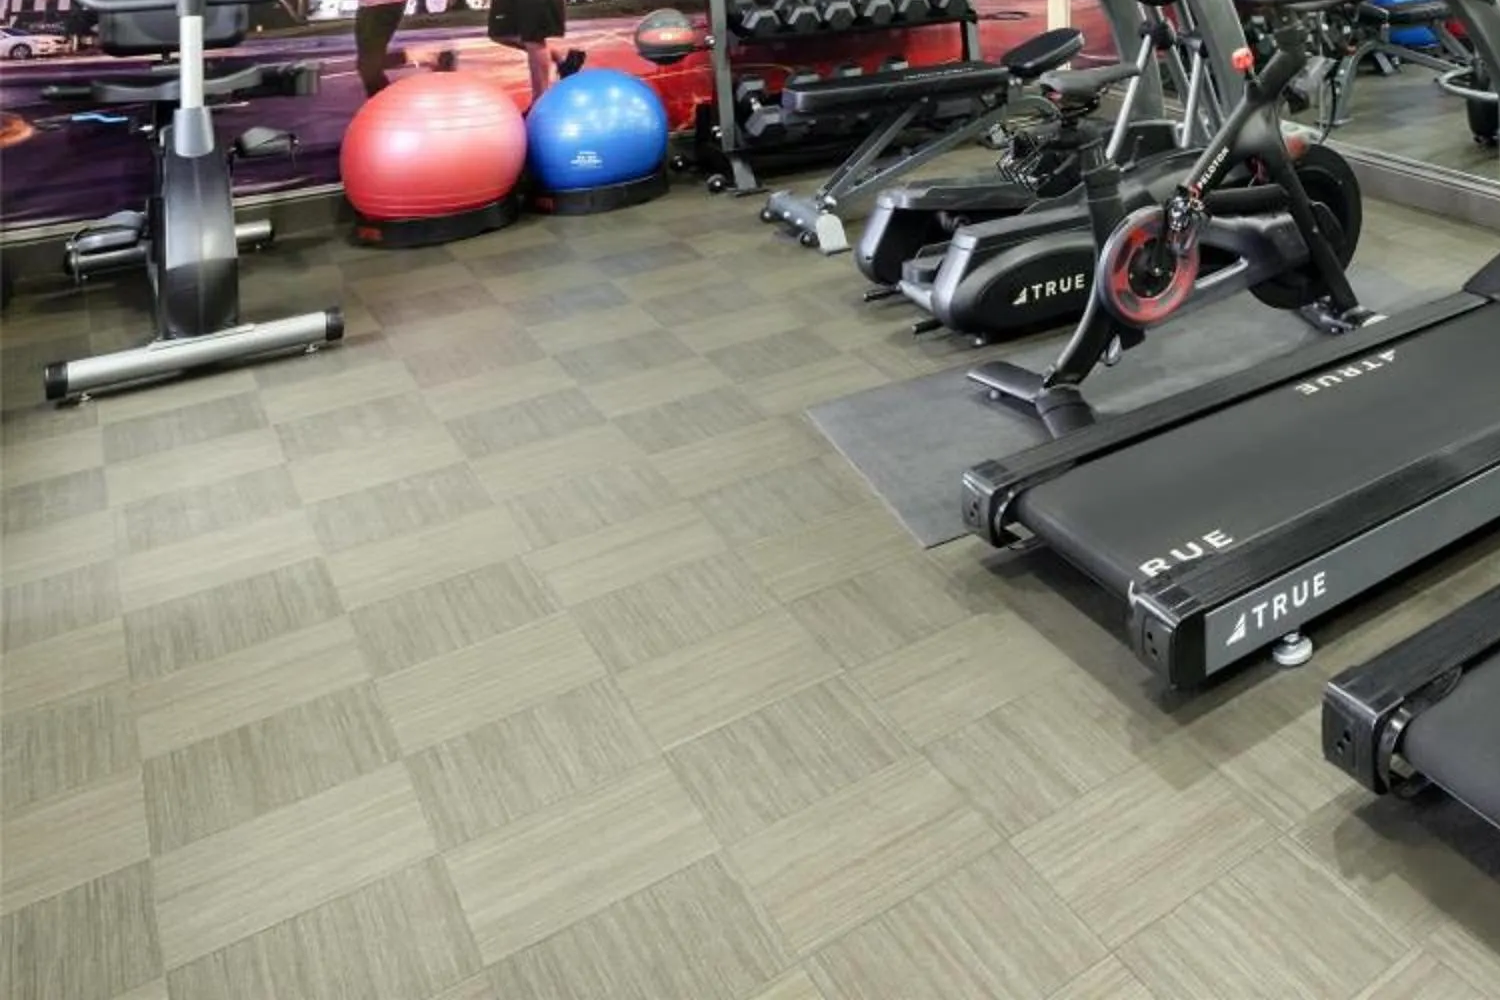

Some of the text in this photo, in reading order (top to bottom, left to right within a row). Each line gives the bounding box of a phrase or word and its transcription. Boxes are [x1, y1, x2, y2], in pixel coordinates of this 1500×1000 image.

[1195, 145, 1230, 190] PELOTON
[1031, 273, 1085, 300] TRUE
[1294, 360, 1384, 396] TRUE
[1139, 529, 1233, 577] RUE
[1252, 571, 1328, 631] TRUE
